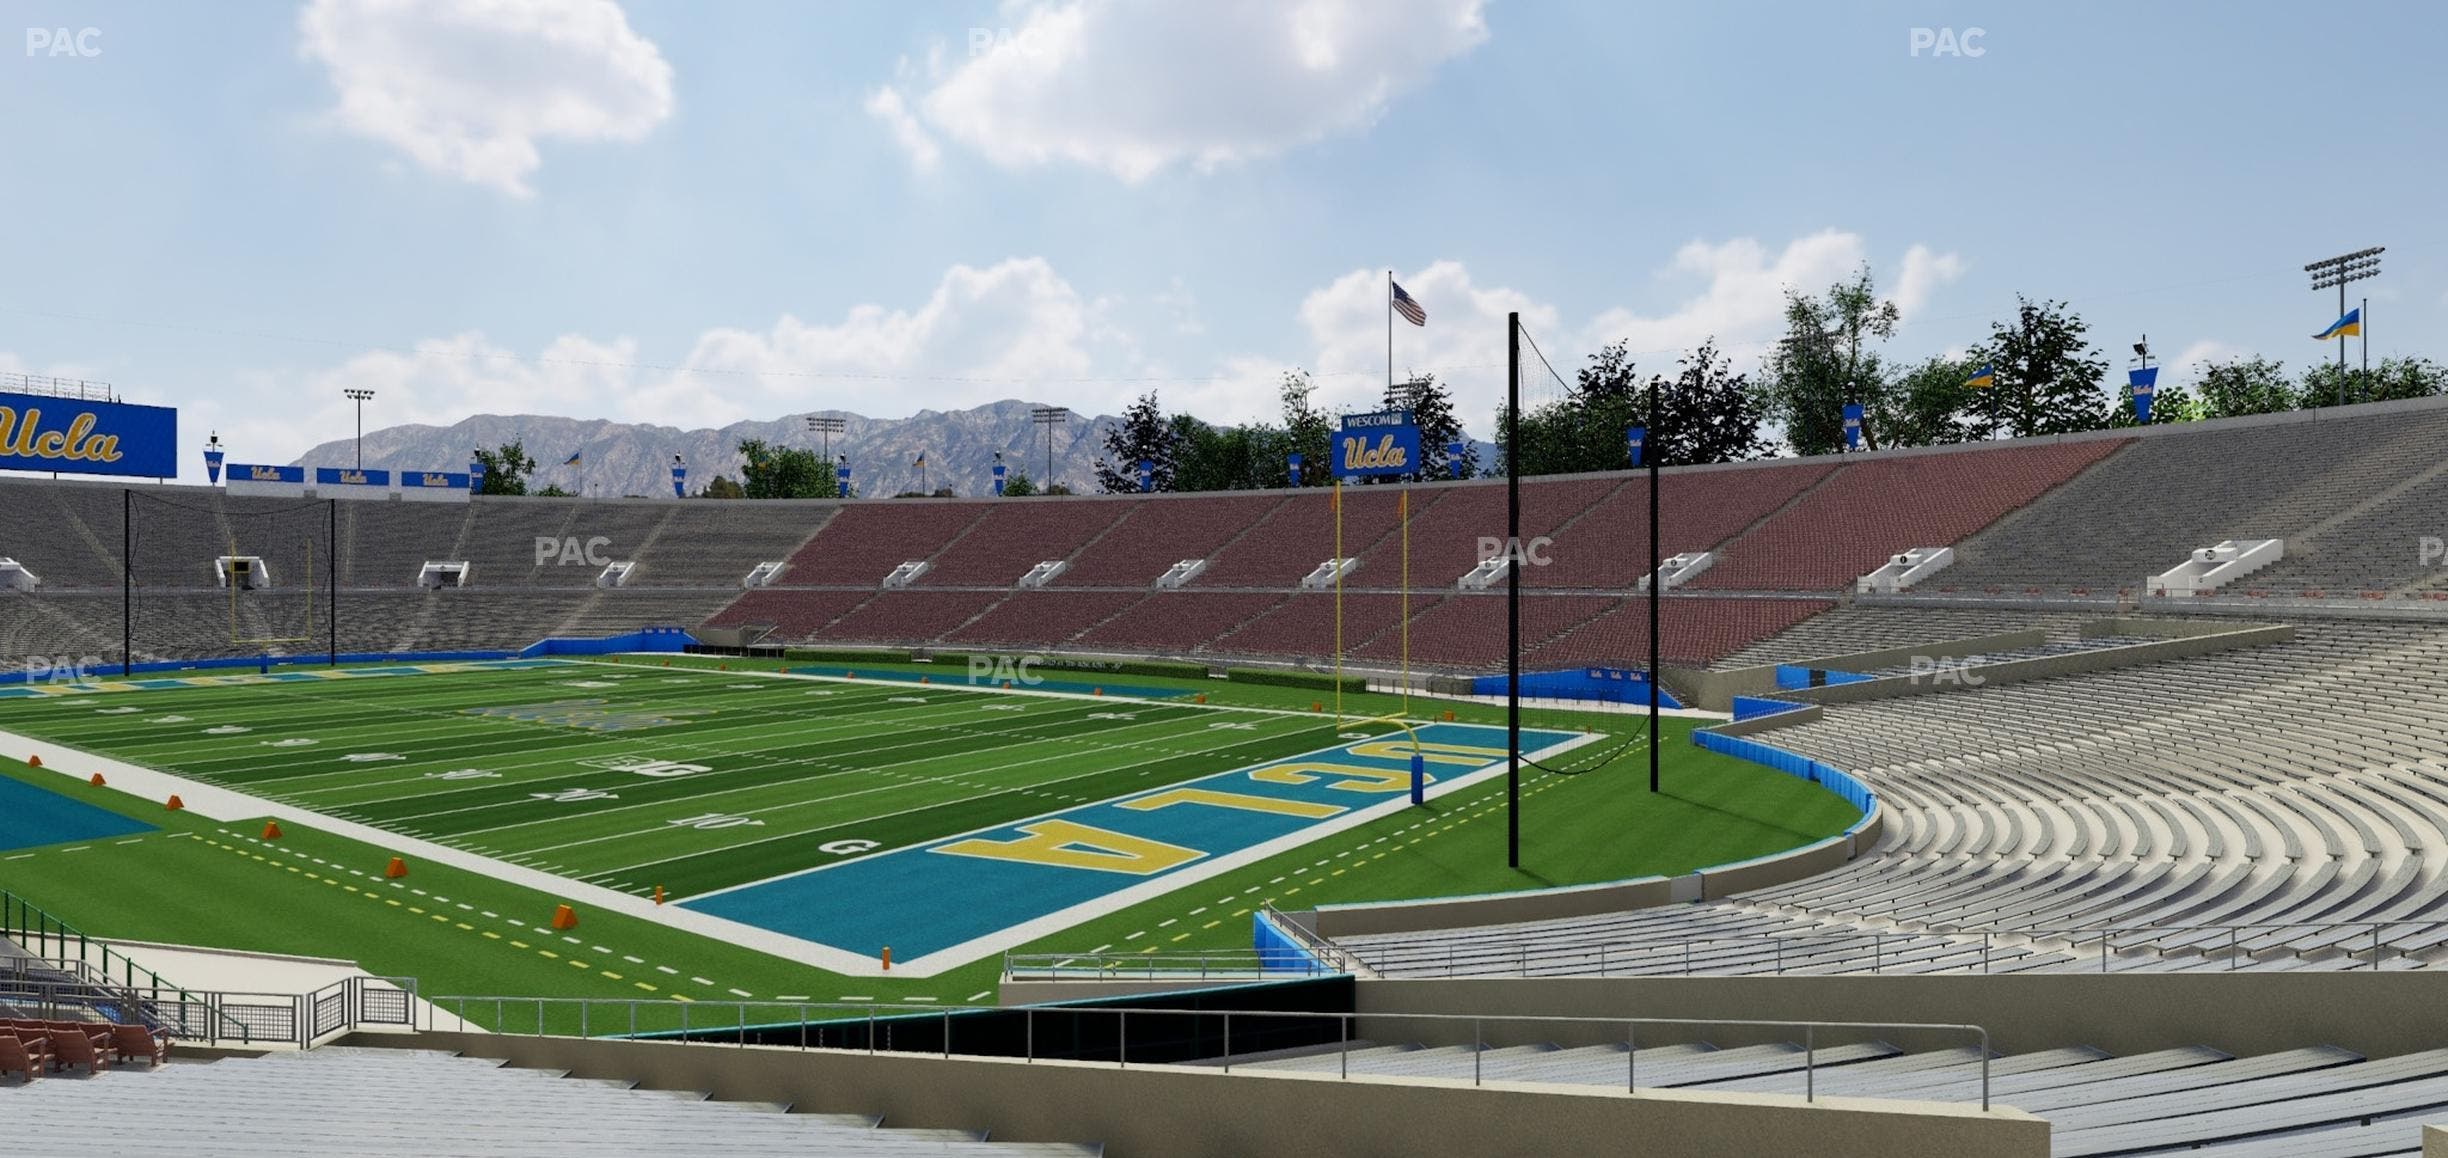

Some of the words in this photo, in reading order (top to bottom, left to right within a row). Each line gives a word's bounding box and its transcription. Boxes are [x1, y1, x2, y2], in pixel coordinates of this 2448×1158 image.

[0, 406, 123, 462] Ucla
[1347, 415, 1391, 427] WESCOM
[1343, 434, 1407, 469] Ucla
[818, 838, 882, 856] G
